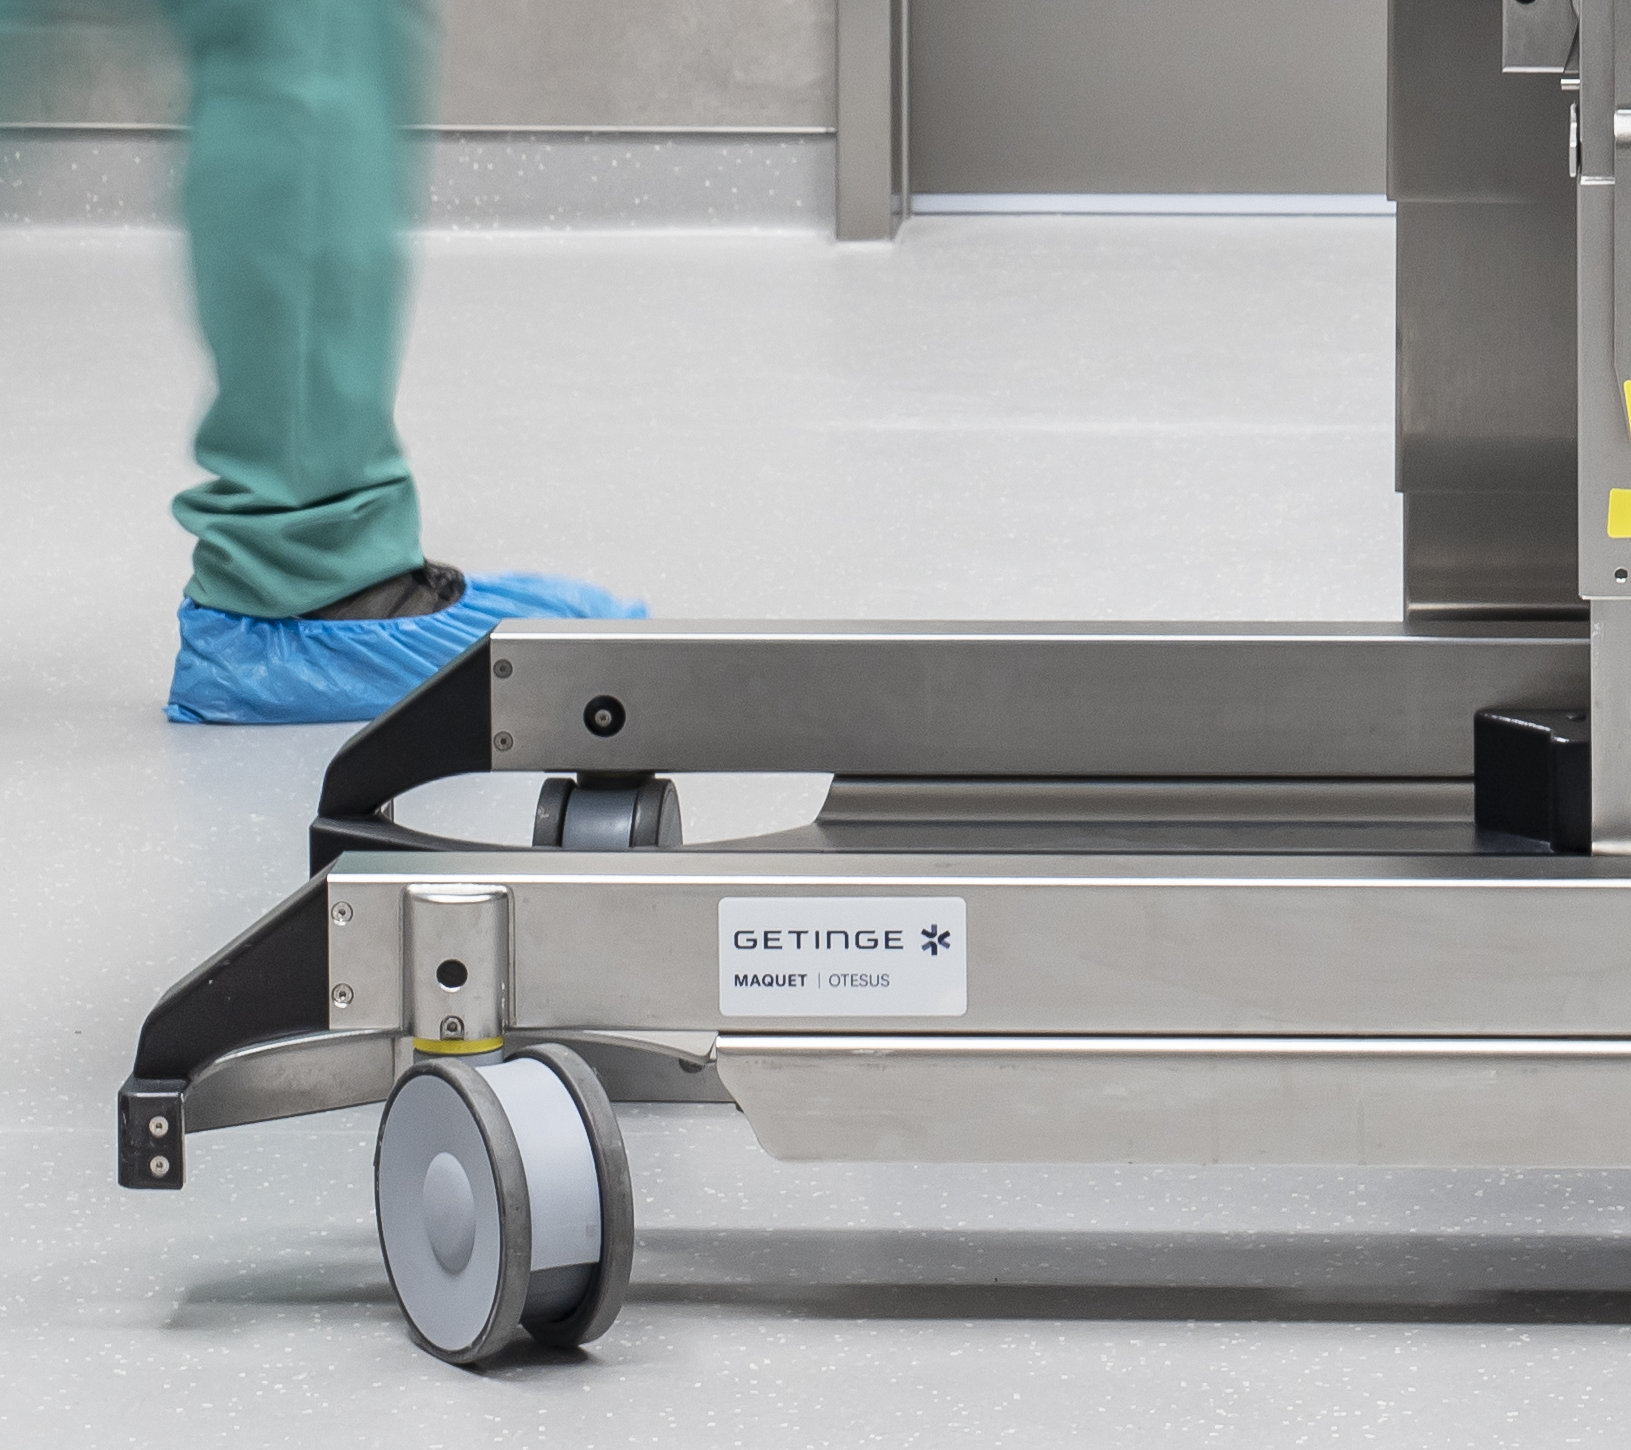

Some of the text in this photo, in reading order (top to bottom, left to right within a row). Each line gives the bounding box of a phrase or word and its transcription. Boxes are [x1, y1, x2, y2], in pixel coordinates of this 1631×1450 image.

[733, 929, 905, 950] GETINGE
[733, 973, 890, 988] MAQUET OTESUS
